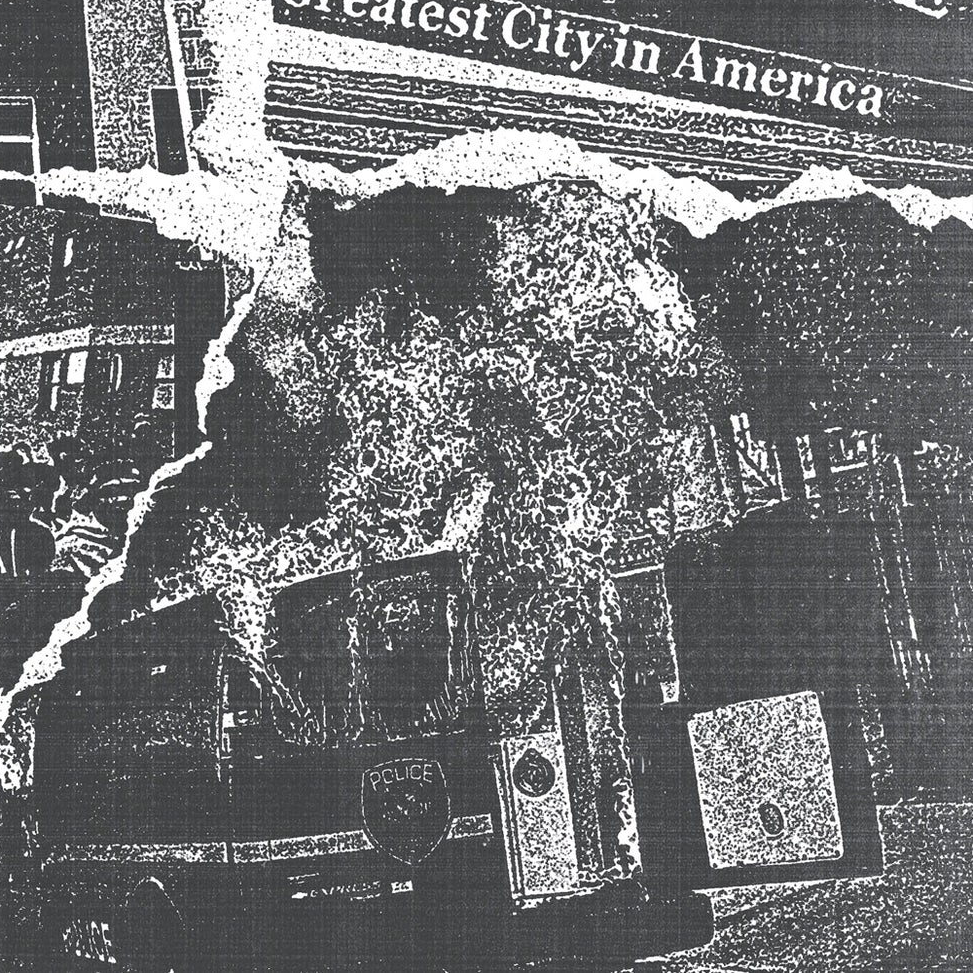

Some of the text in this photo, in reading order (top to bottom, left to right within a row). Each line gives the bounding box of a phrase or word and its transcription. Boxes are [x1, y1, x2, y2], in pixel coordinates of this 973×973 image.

[502, 3, 605, 72] City
[610, 22, 662, 75] in
[671, 37, 882, 119] America
[369, 763, 434, 792] POLICE
